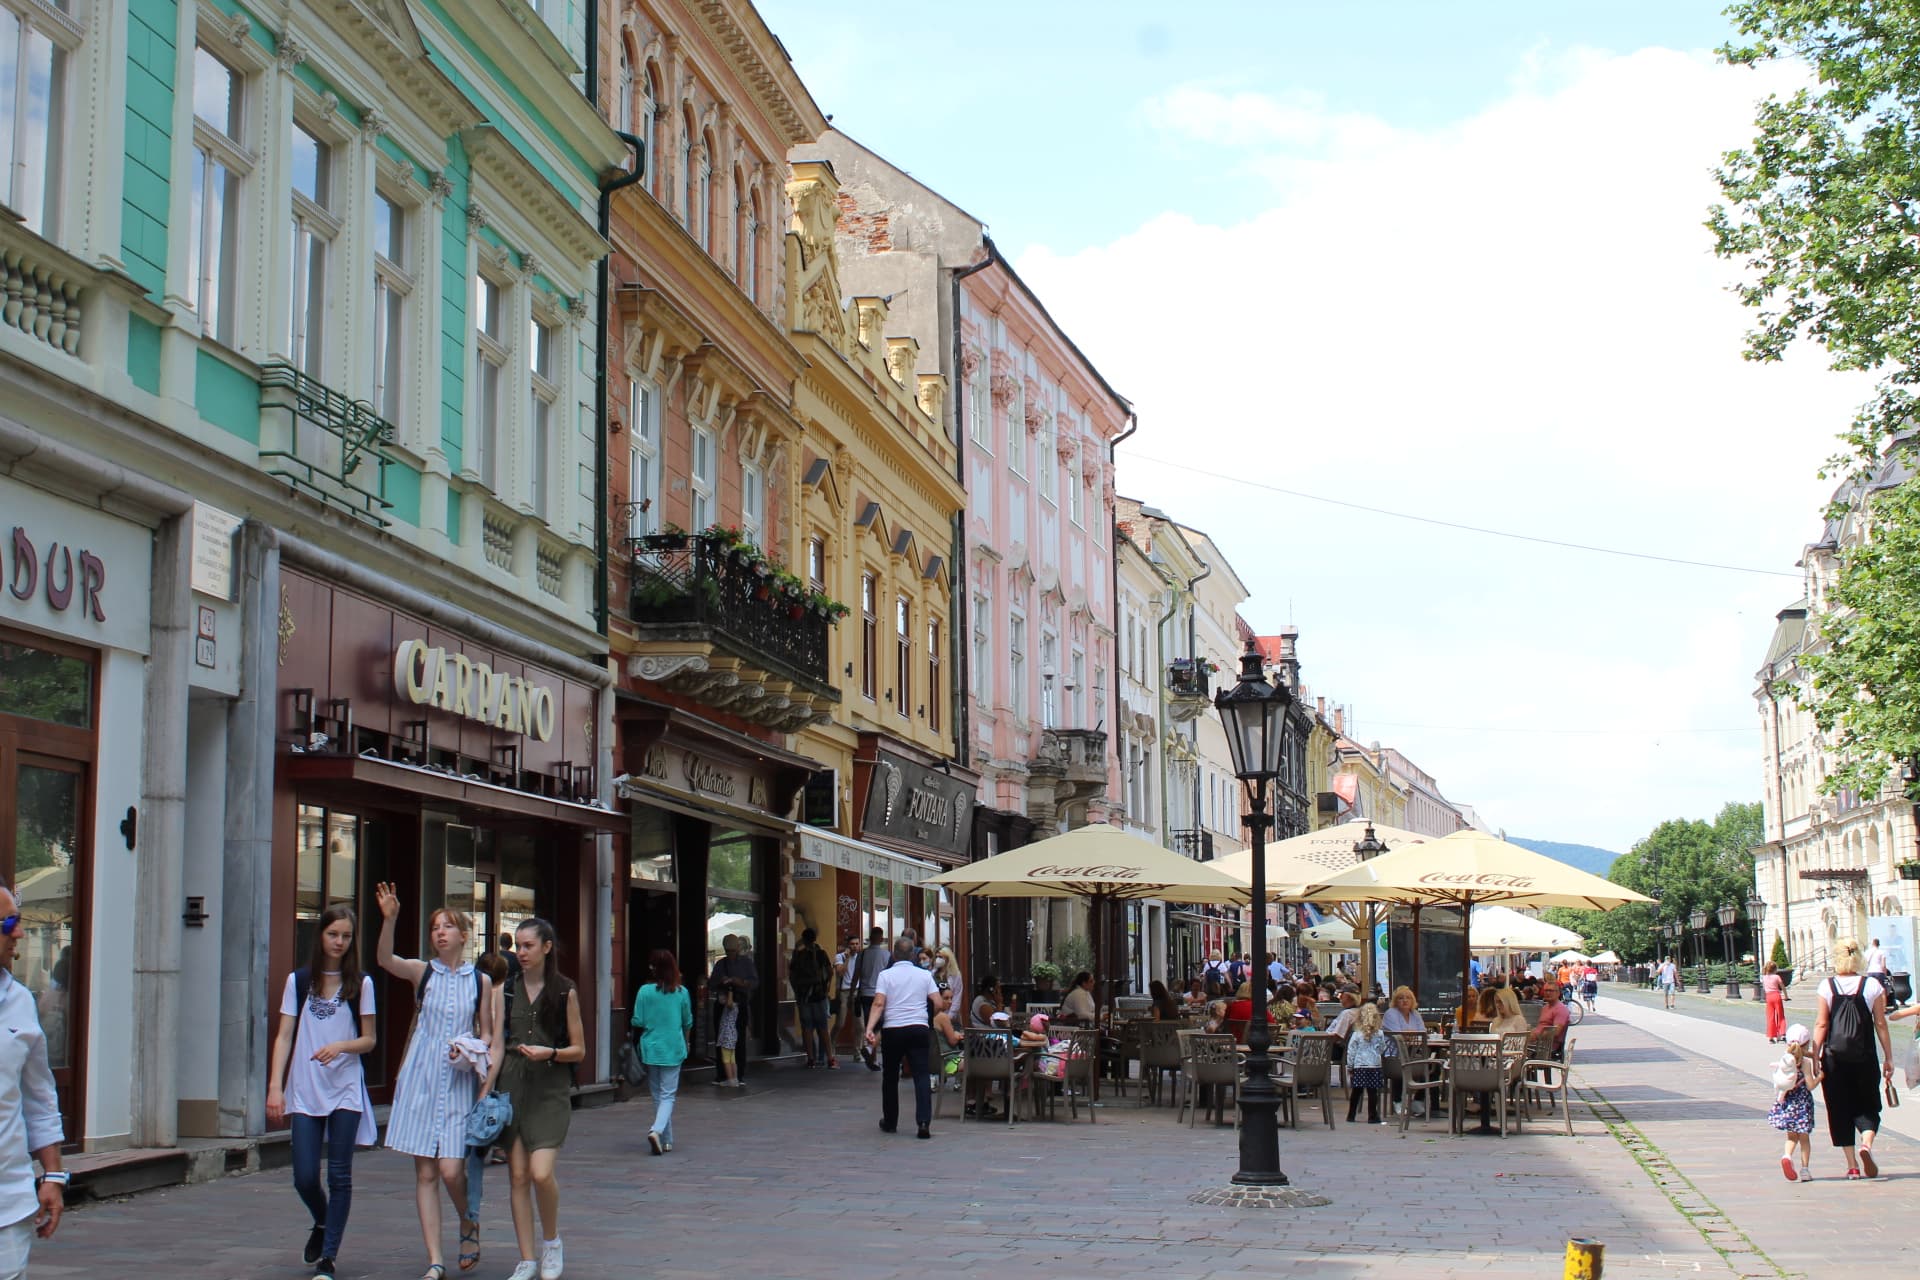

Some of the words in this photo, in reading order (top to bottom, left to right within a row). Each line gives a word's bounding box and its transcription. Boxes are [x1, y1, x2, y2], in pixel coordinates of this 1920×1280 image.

[0, 527, 105, 622] DUR
[406, 638, 554, 742] CARPANO
[908, 788, 949, 827] FONTANA
